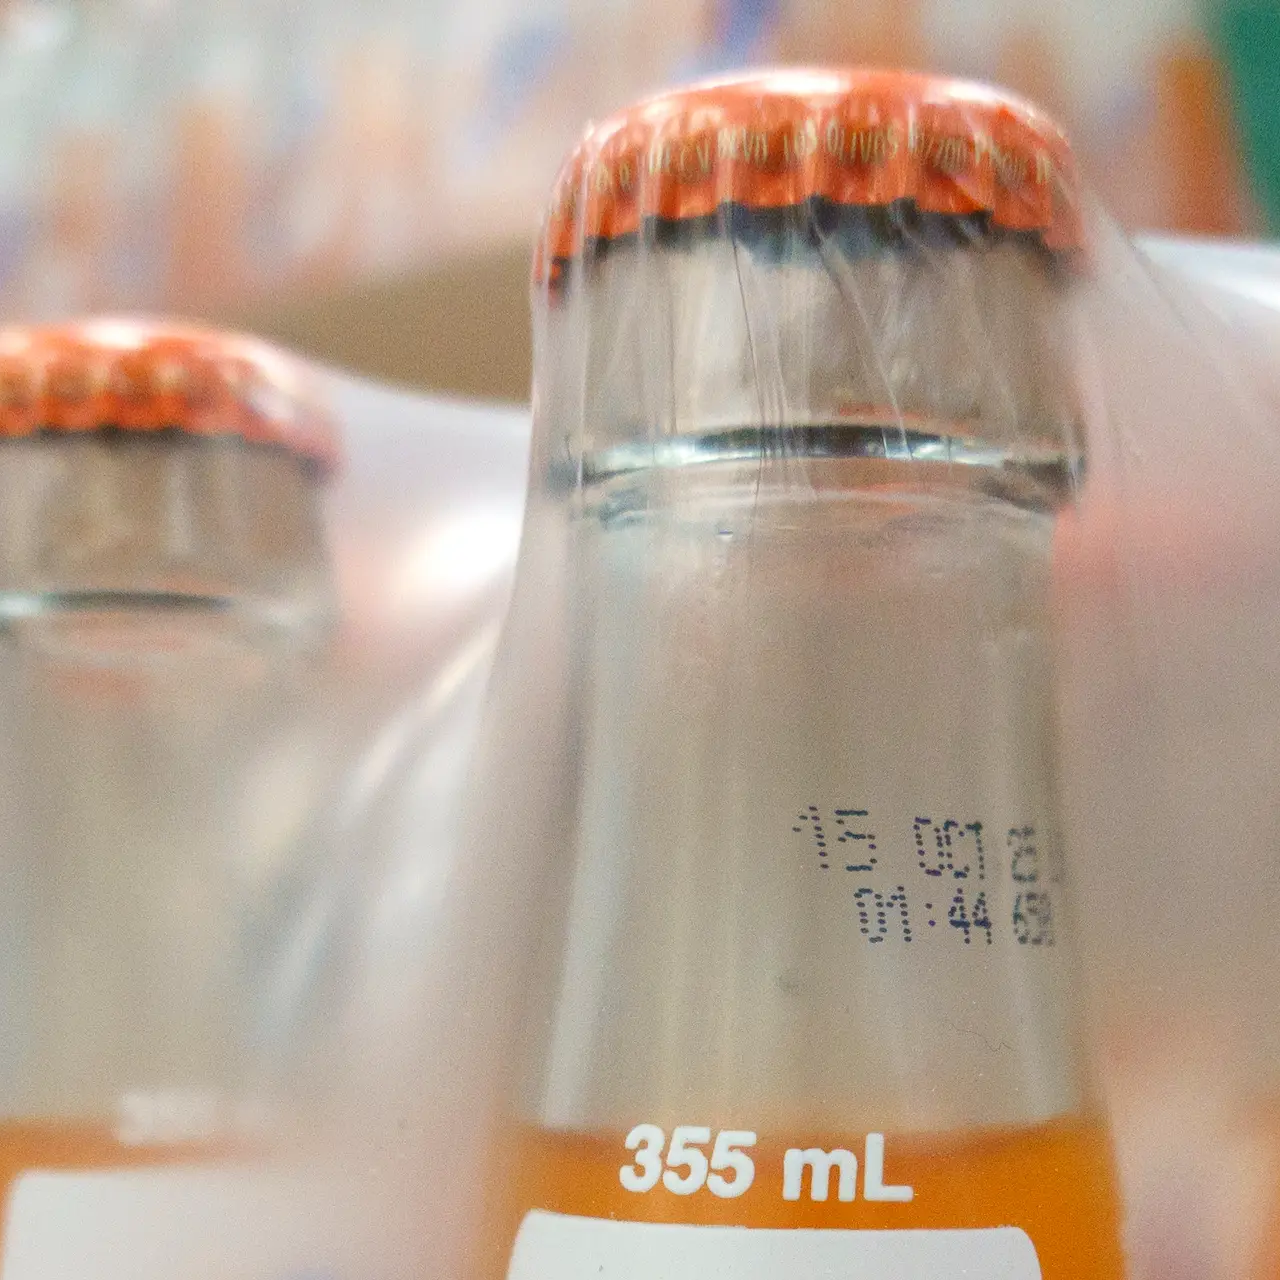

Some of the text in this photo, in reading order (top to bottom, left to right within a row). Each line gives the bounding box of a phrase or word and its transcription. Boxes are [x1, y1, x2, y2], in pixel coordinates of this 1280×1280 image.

[793, 805, 877, 871] 15
[915, 817, 983, 880] OCT
[853, 886, 992, 944] 01:44
[620, 1124, 914, 1202] 355 mL
